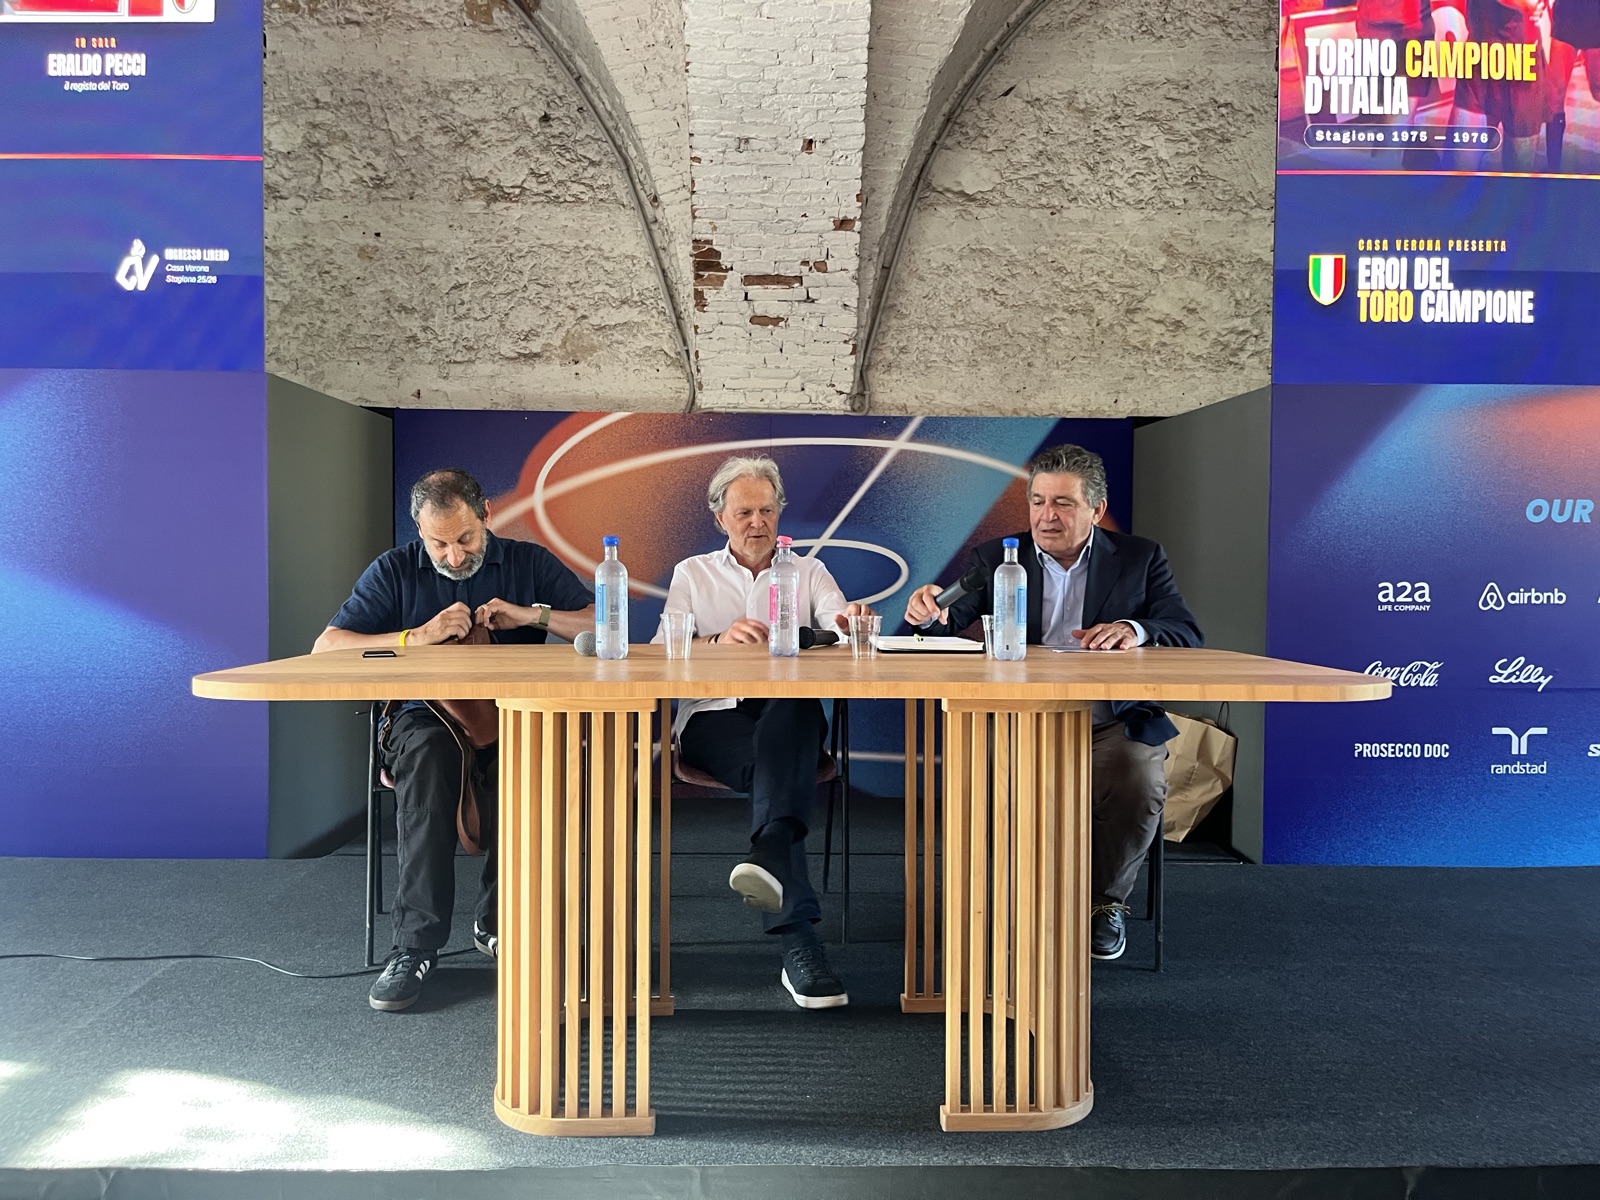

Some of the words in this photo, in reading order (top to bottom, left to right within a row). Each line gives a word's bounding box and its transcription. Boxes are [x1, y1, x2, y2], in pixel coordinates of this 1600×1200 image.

[48, 53, 102, 76] ERALDO
[105, 53, 146, 76] PECCI
[1304, 38, 1397, 77] TORINO
[1405, 39, 1537, 81] CAMPIONE
[70, 81, 97, 92] regista
[98, 81, 111, 90] del
[112, 81, 129, 90] Toro
[1304, 76, 1409, 115] D'ITALIA
[1315, 129, 1385, 144] Stagione
[1391, 130, 1428, 142] 1975
[1453, 132, 1489, 143] 1976
[1358, 239, 1389, 251] CASA
[1395, 239, 1441, 252] VERONA
[1448, 239, 1507, 252] PRESENTA
[165, 263, 184, 272] Casa
[1358, 256, 1408, 290] EROI
[1413, 257, 1454, 290] DEL
[165, 274, 197, 285] Stagione
[1357, 290, 1414, 323] TORO
[1420, 290, 1535, 323] CAMPIONE
[1525, 498, 1595, 523] OUR
[1377, 581, 1431, 603] a2a
[1507, 588, 1567, 605] airbnb
[1377, 604, 1393, 612] LIFE
[1394, 604, 1431, 612] COMPANY
[1489, 656, 1553, 692] Lilly
[1354, 743, 1421, 758] PROSECCO
[1424, 743, 1450, 758] DOC
[1490, 761, 1547, 774] randstad
